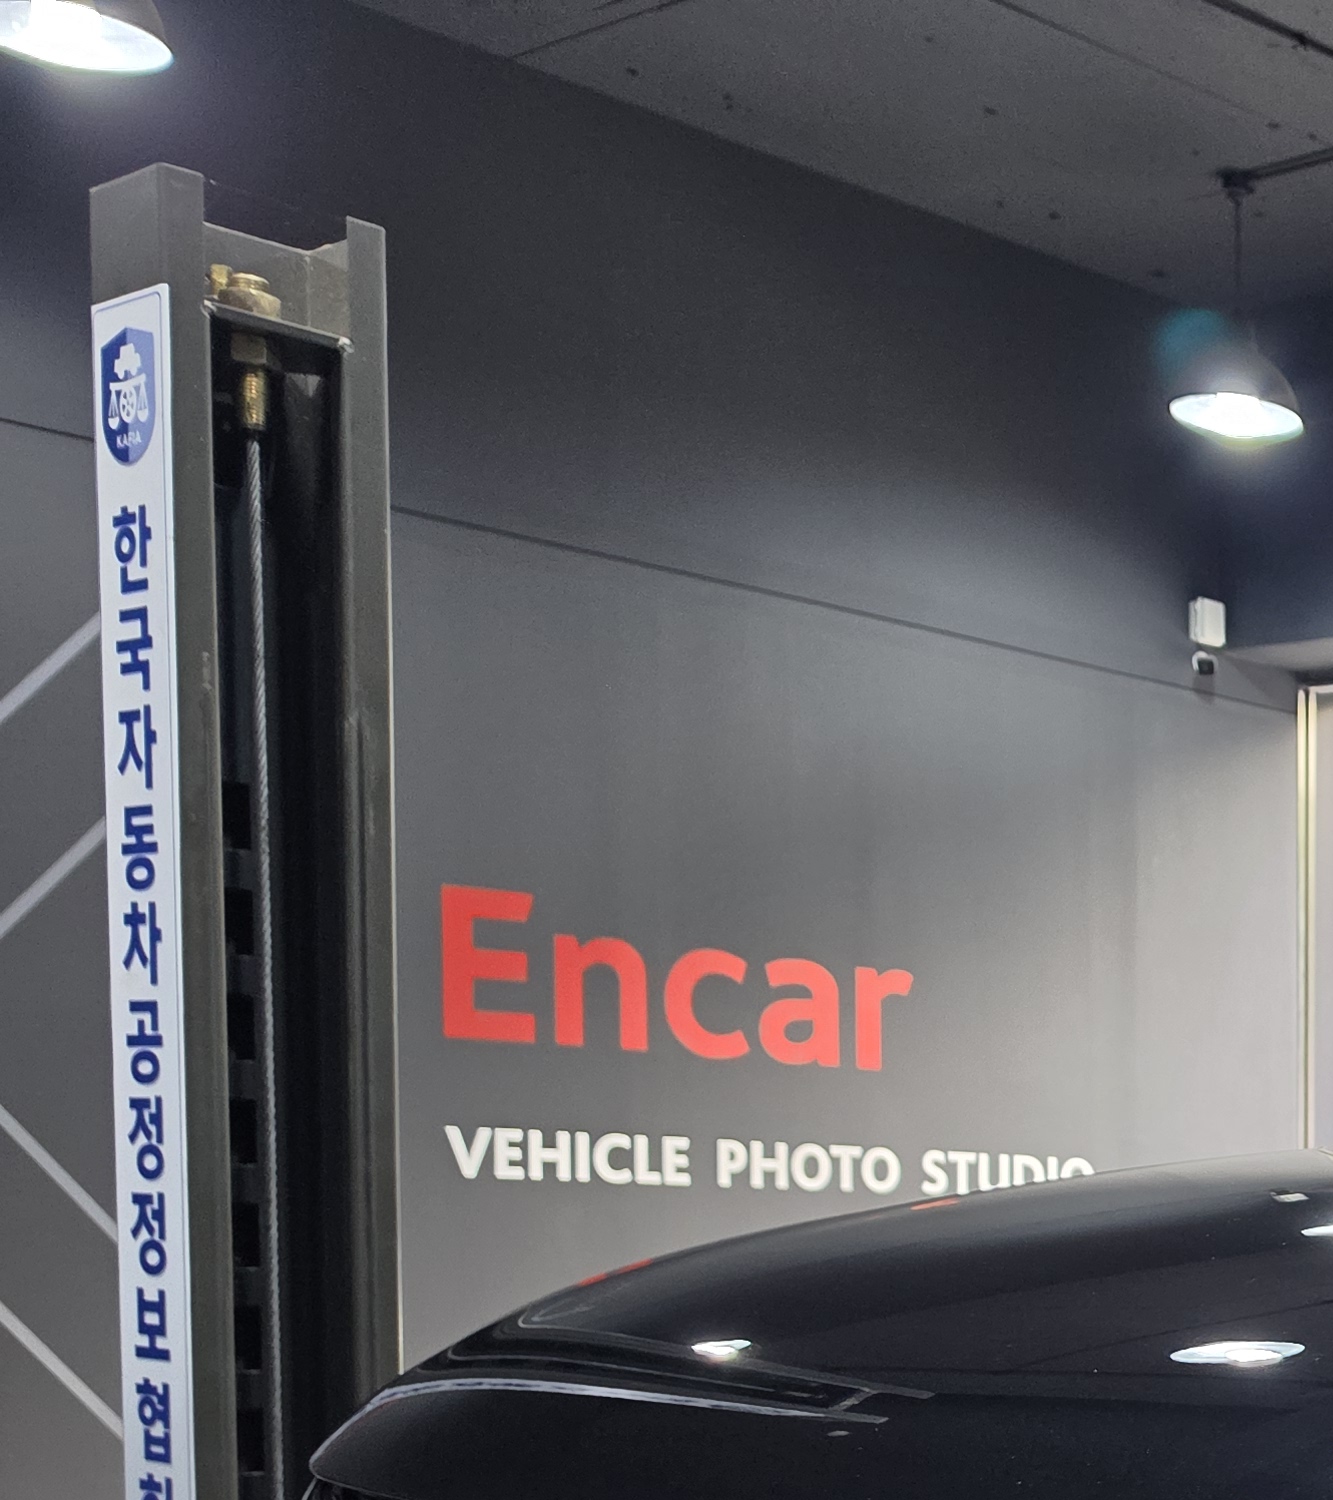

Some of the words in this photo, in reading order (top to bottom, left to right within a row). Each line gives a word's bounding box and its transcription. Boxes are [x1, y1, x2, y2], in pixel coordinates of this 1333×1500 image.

[440, 883, 914, 1072] Encar
[444, 1125, 692, 1186] VEHICLE
[716, 1138, 901, 1193] PHOTO
